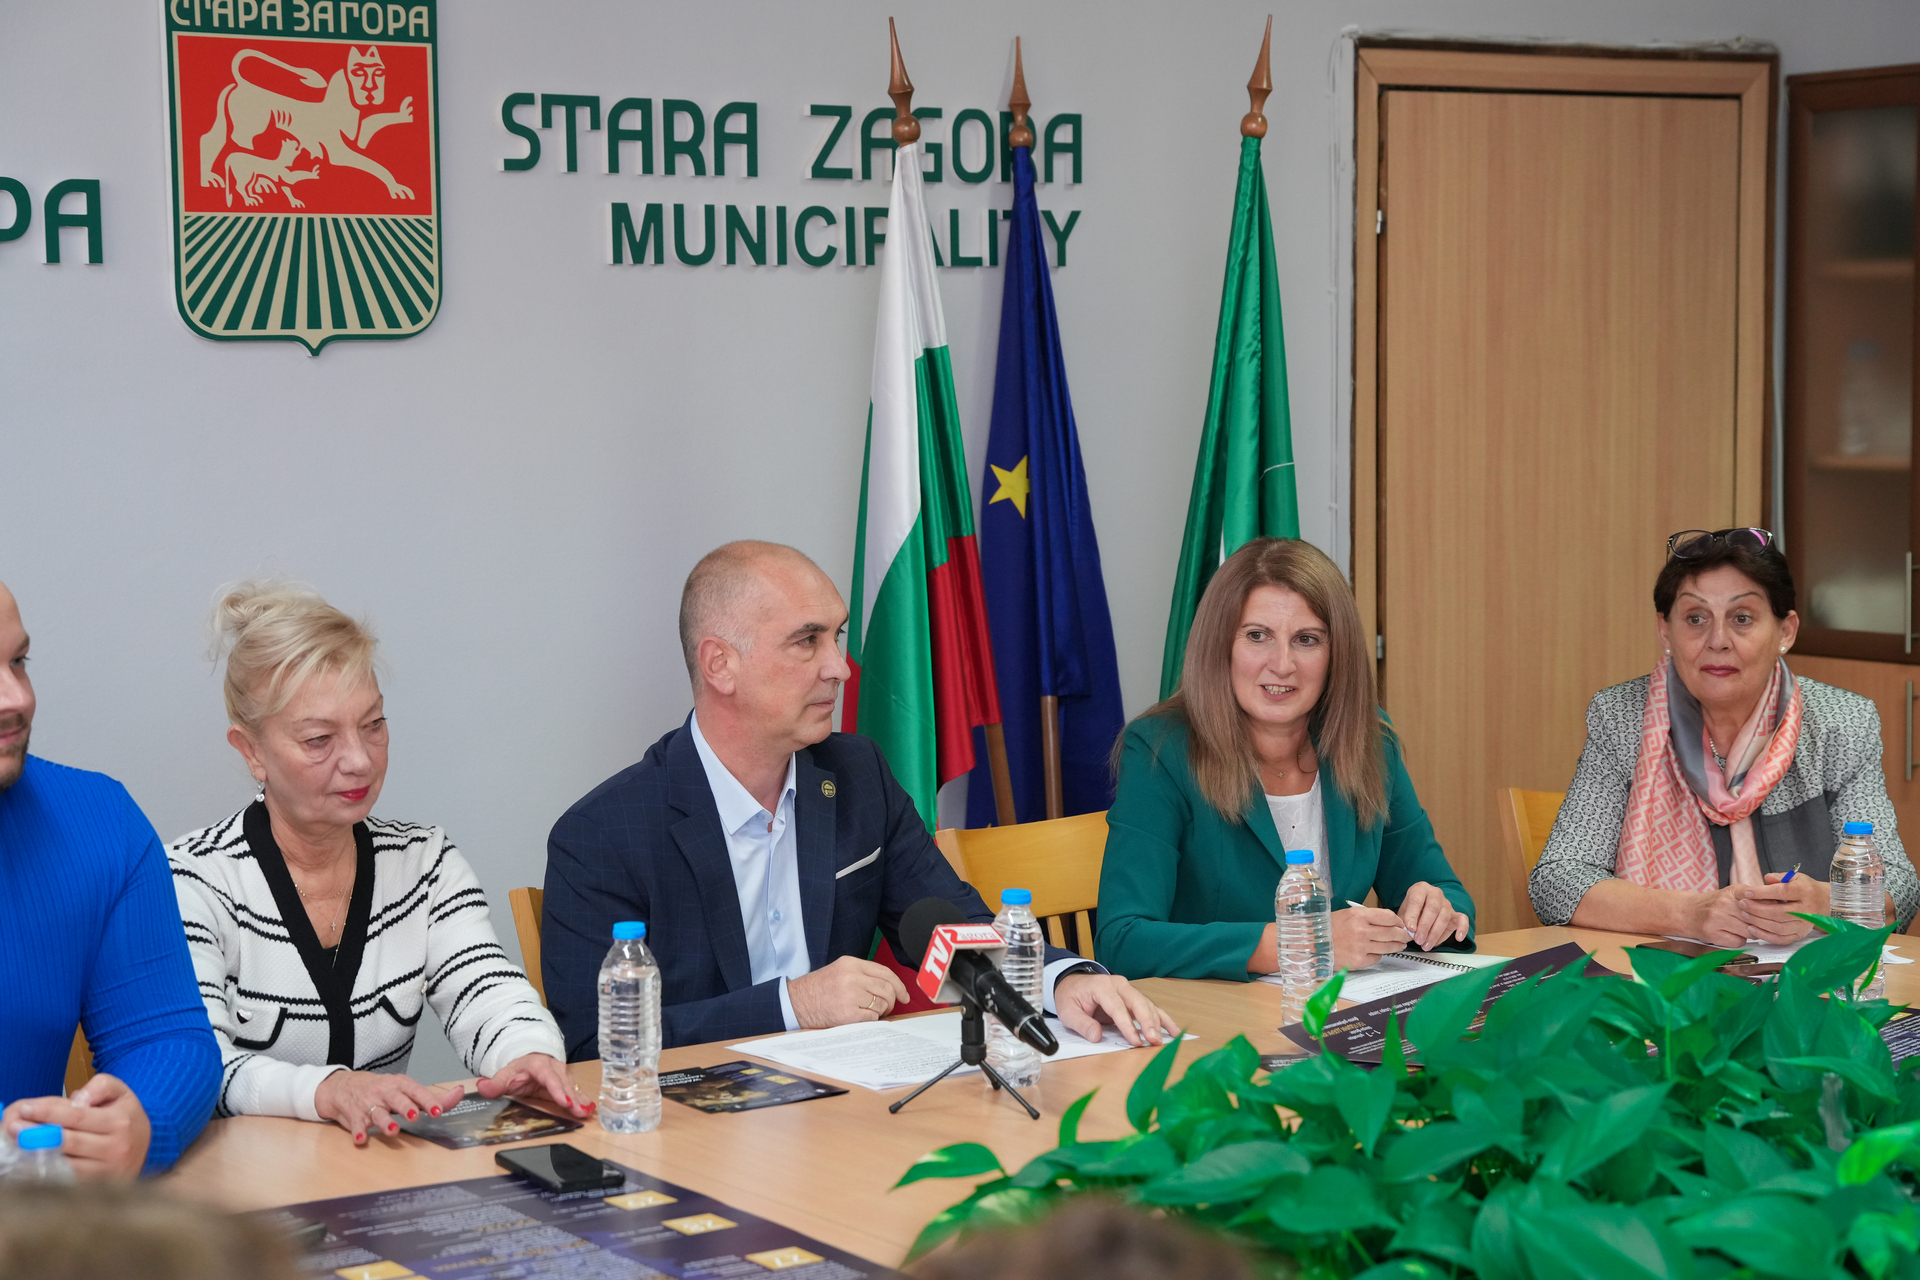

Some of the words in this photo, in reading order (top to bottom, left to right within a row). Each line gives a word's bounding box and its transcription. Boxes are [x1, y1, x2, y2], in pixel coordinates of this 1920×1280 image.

[170, 0, 283, 30] СТАРА
[293, 0, 429, 37] ЗАГОРА
[501, 92, 758, 177] STARA
[611, 202, 1082, 267] MUNICIPLIY
[925, 934, 949, 981] TV
